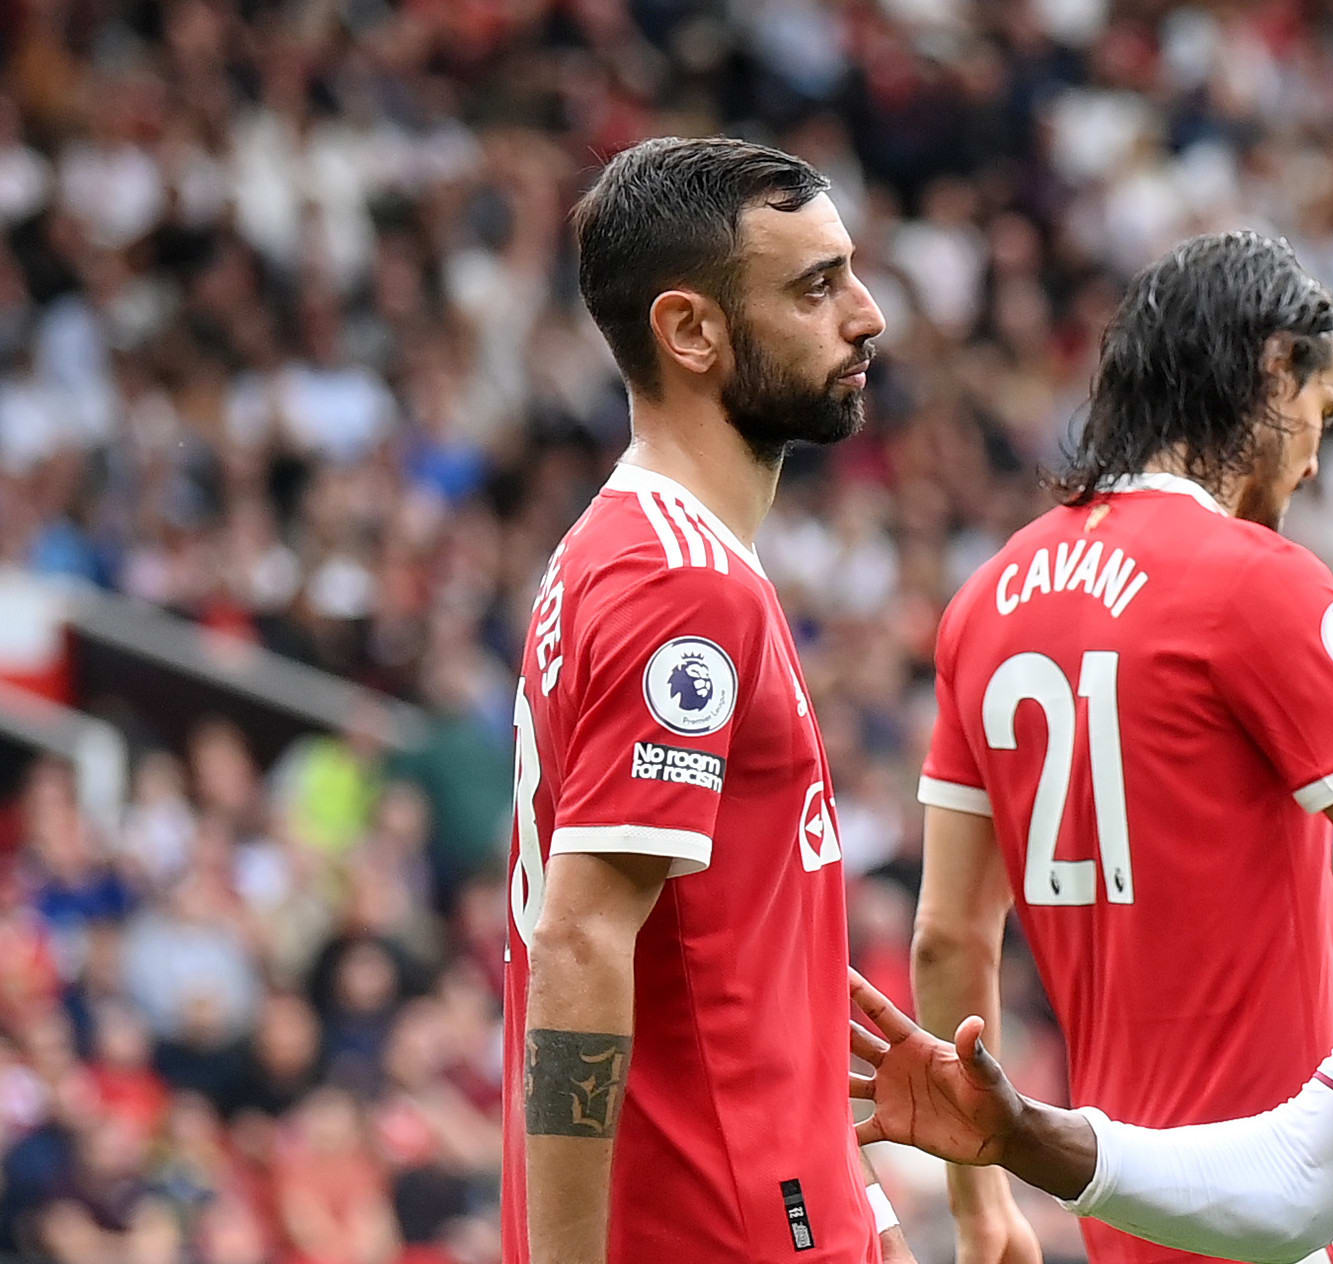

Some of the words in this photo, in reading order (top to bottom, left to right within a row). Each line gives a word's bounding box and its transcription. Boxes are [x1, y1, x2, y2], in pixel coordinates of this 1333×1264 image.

[996, 539, 1149, 618] CAVANI
[631, 759, 663, 778] for
[662, 766, 723, 794] racism
[633, 742, 665, 764] No
[666, 750, 721, 775] room
[981, 650, 1134, 906] 21
